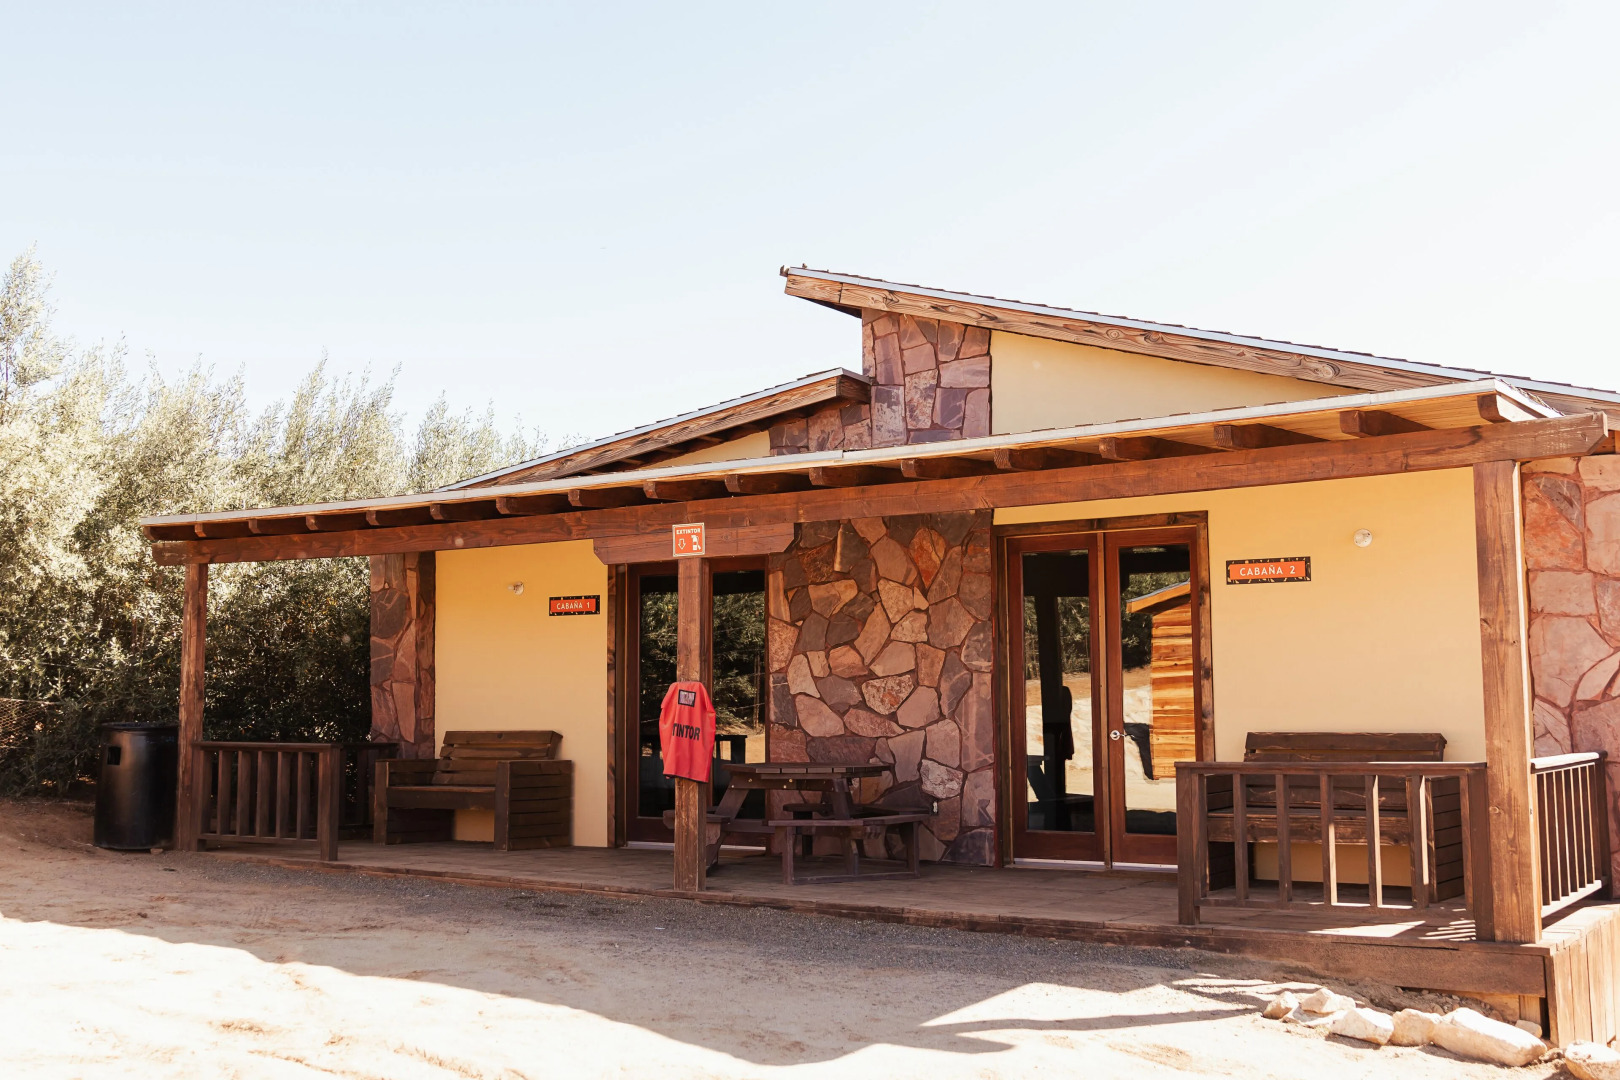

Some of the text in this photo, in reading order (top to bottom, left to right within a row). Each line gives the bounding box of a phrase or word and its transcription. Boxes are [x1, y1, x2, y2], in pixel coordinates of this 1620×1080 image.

[1239, 565, 1296, 576] CABAÑA 2
[556, 600, 590, 610] CABAÑA 1
